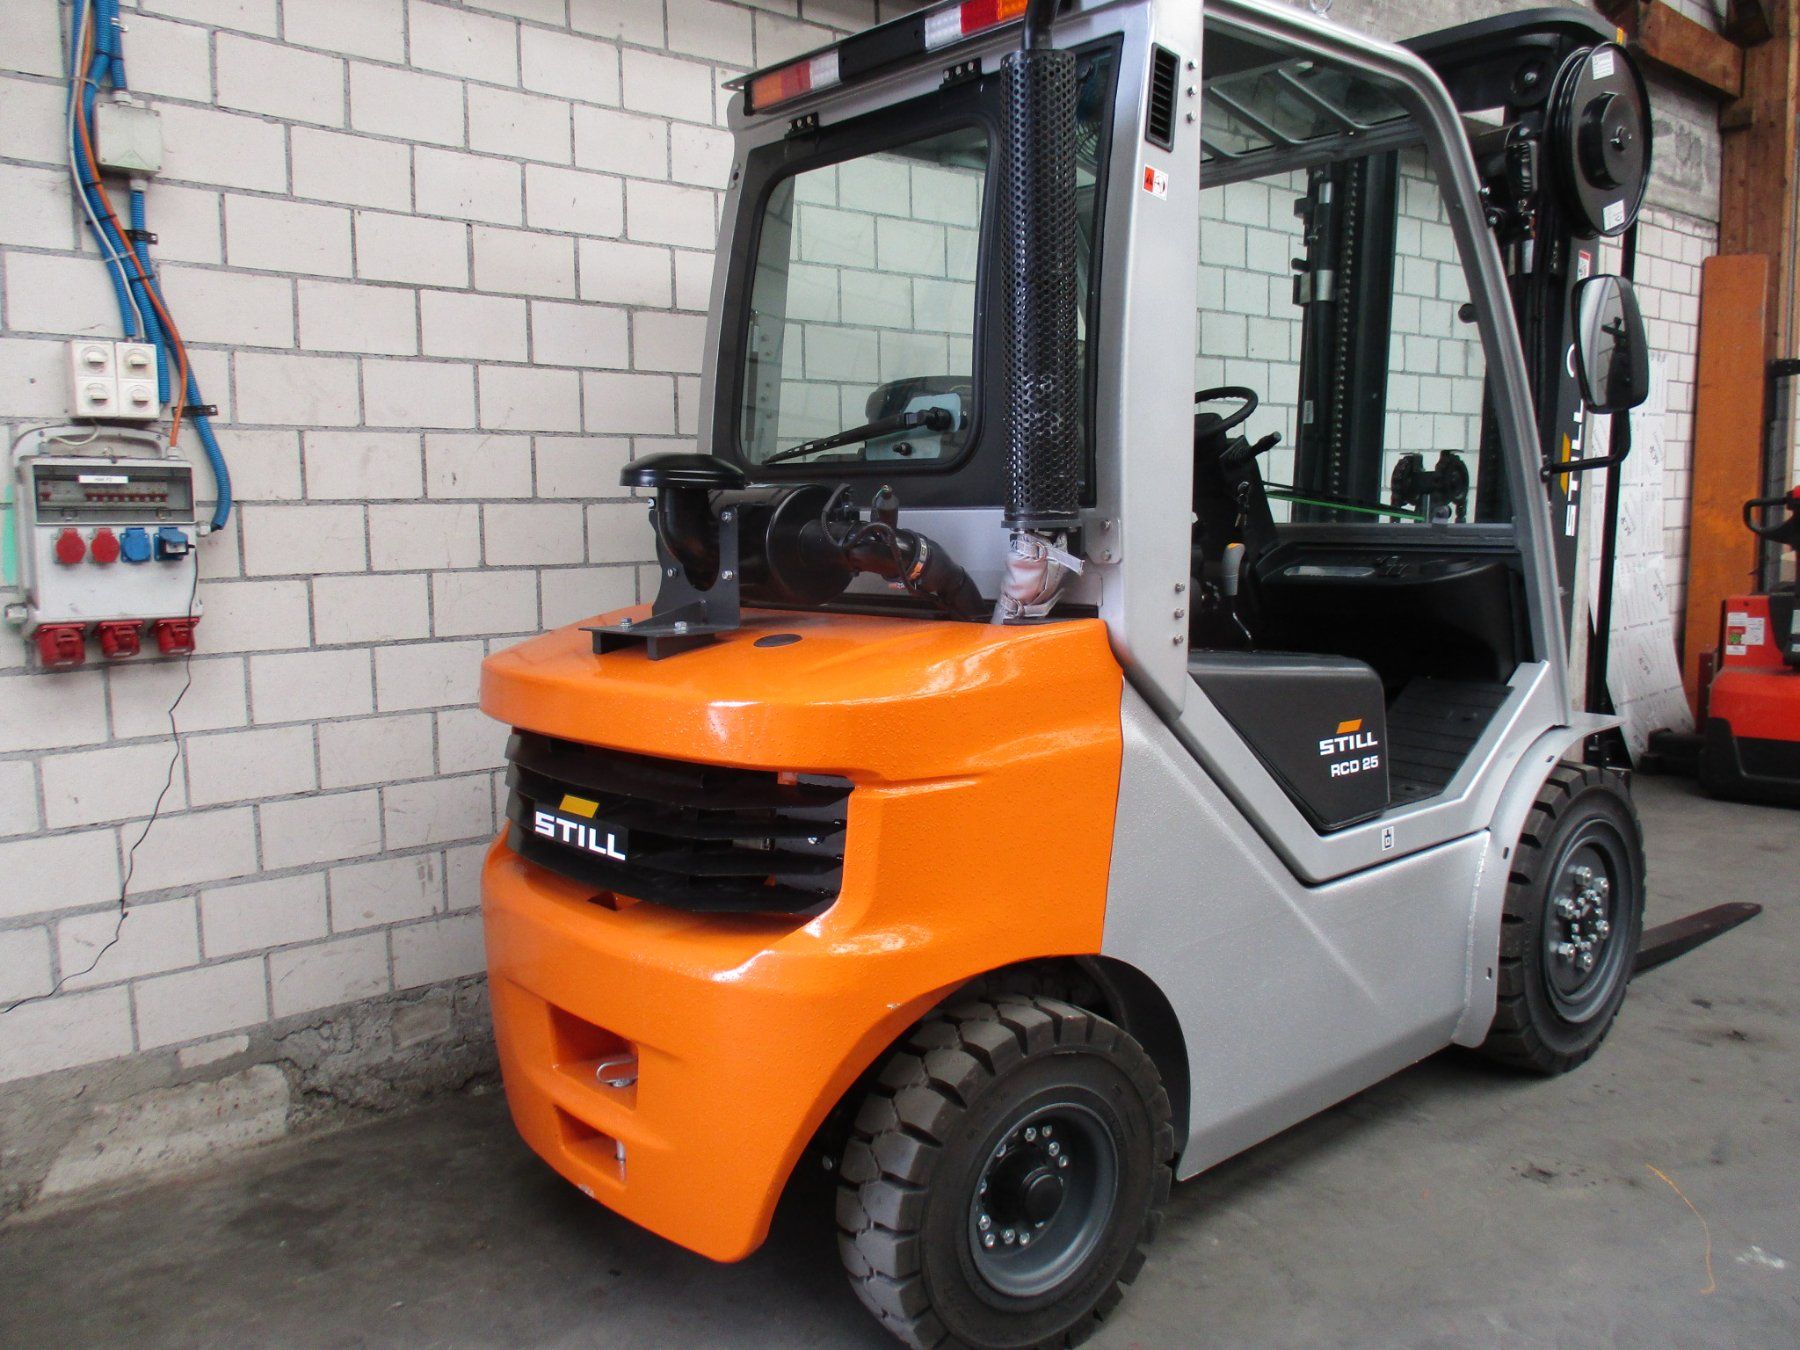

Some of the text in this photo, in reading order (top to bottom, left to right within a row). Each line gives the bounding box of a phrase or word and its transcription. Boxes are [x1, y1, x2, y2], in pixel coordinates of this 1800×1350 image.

[1319, 731, 1378, 755] STILL
[1330, 755, 1378, 777] RCD 25
[535, 811, 625, 860] STILL
